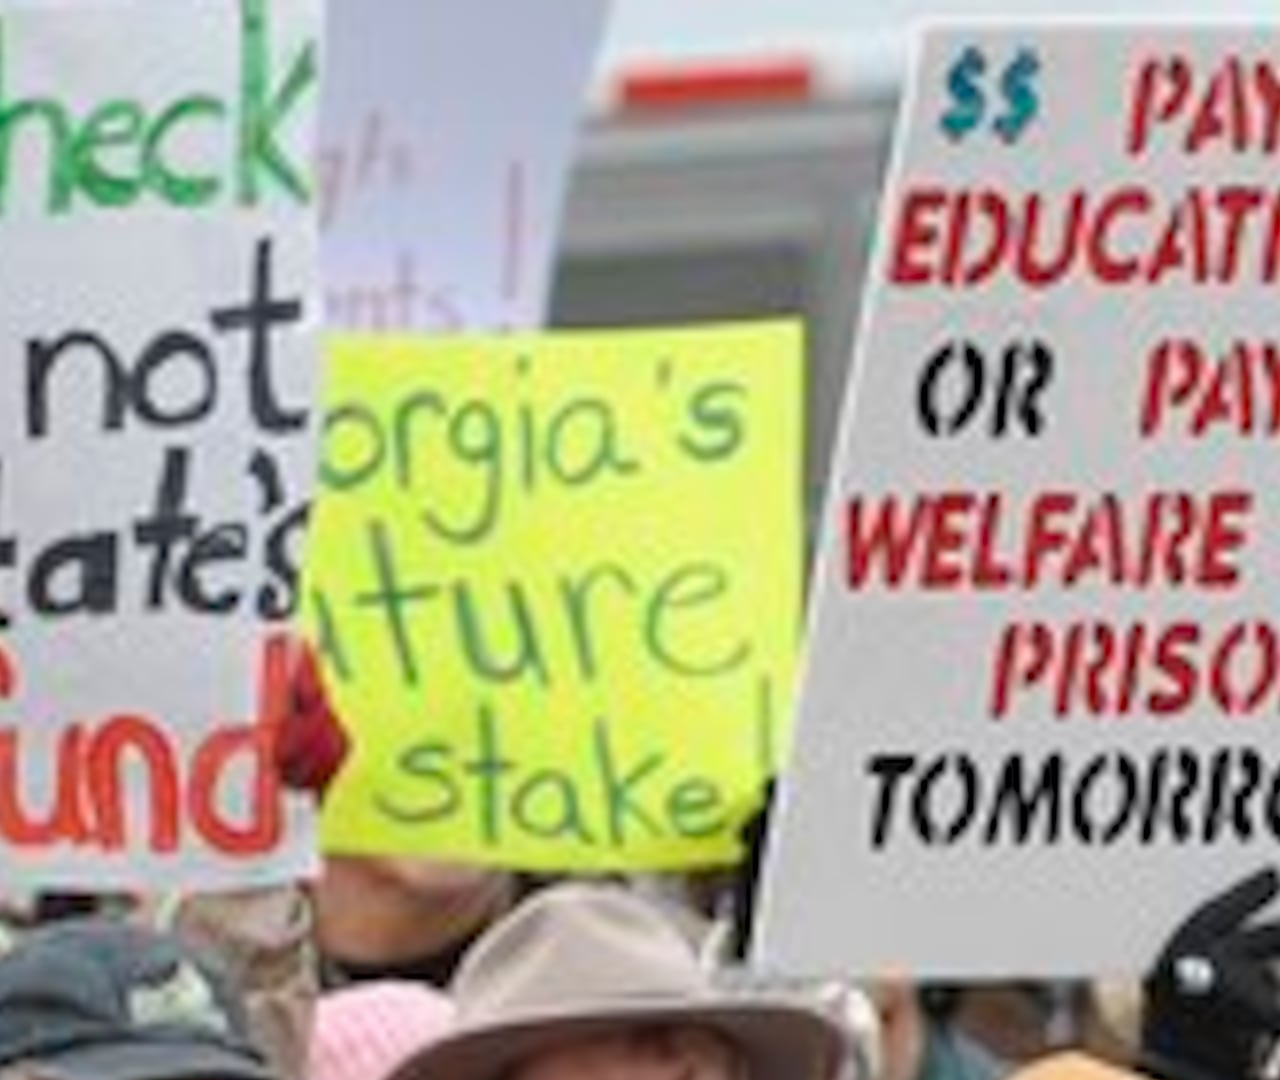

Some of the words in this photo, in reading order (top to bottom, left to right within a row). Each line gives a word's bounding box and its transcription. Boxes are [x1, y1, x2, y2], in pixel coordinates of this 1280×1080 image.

[24, 238, 308, 437] not
[914, 339, 1055, 440] OR
[842, 491, 1255, 591] WELFARE
